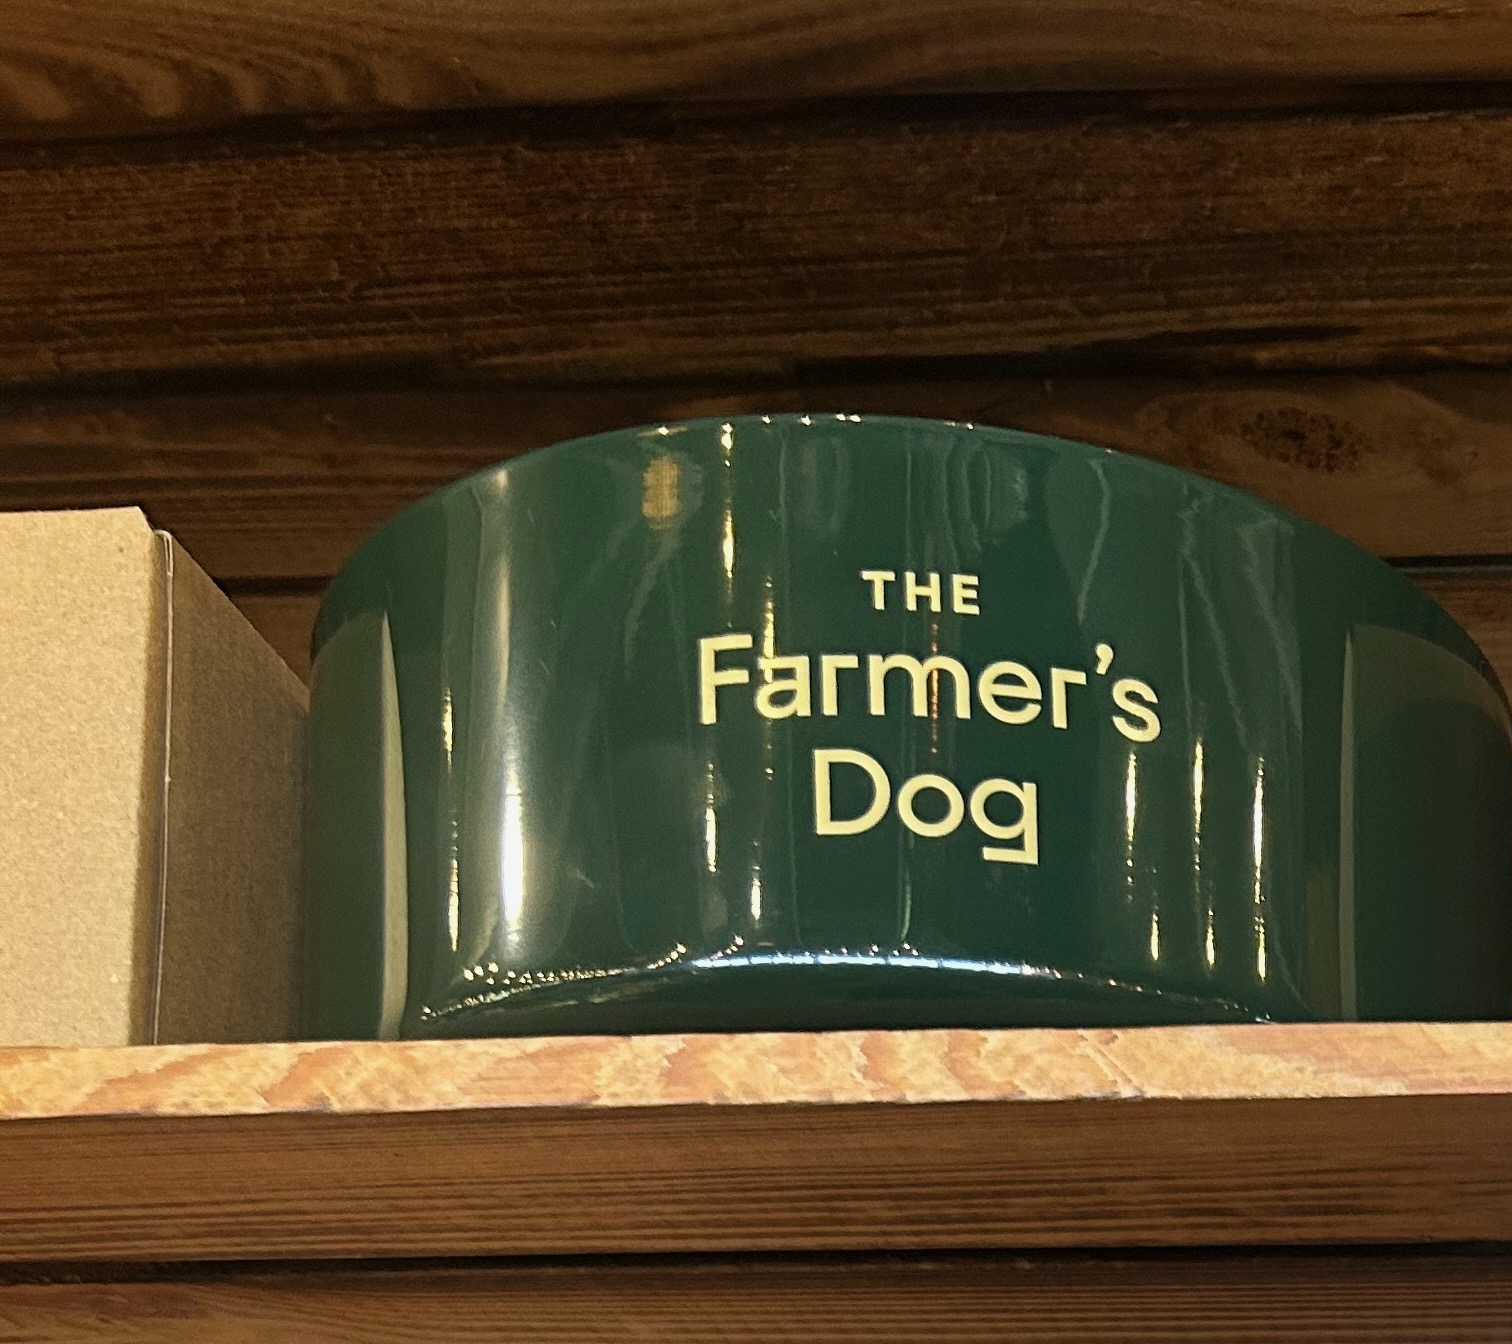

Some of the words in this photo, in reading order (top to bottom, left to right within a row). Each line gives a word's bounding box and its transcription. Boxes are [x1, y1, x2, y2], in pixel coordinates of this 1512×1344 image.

[861, 570, 980, 615] THE
[700, 634, 1162, 742] Farmer's
[813, 749, 1039, 865] Dog
